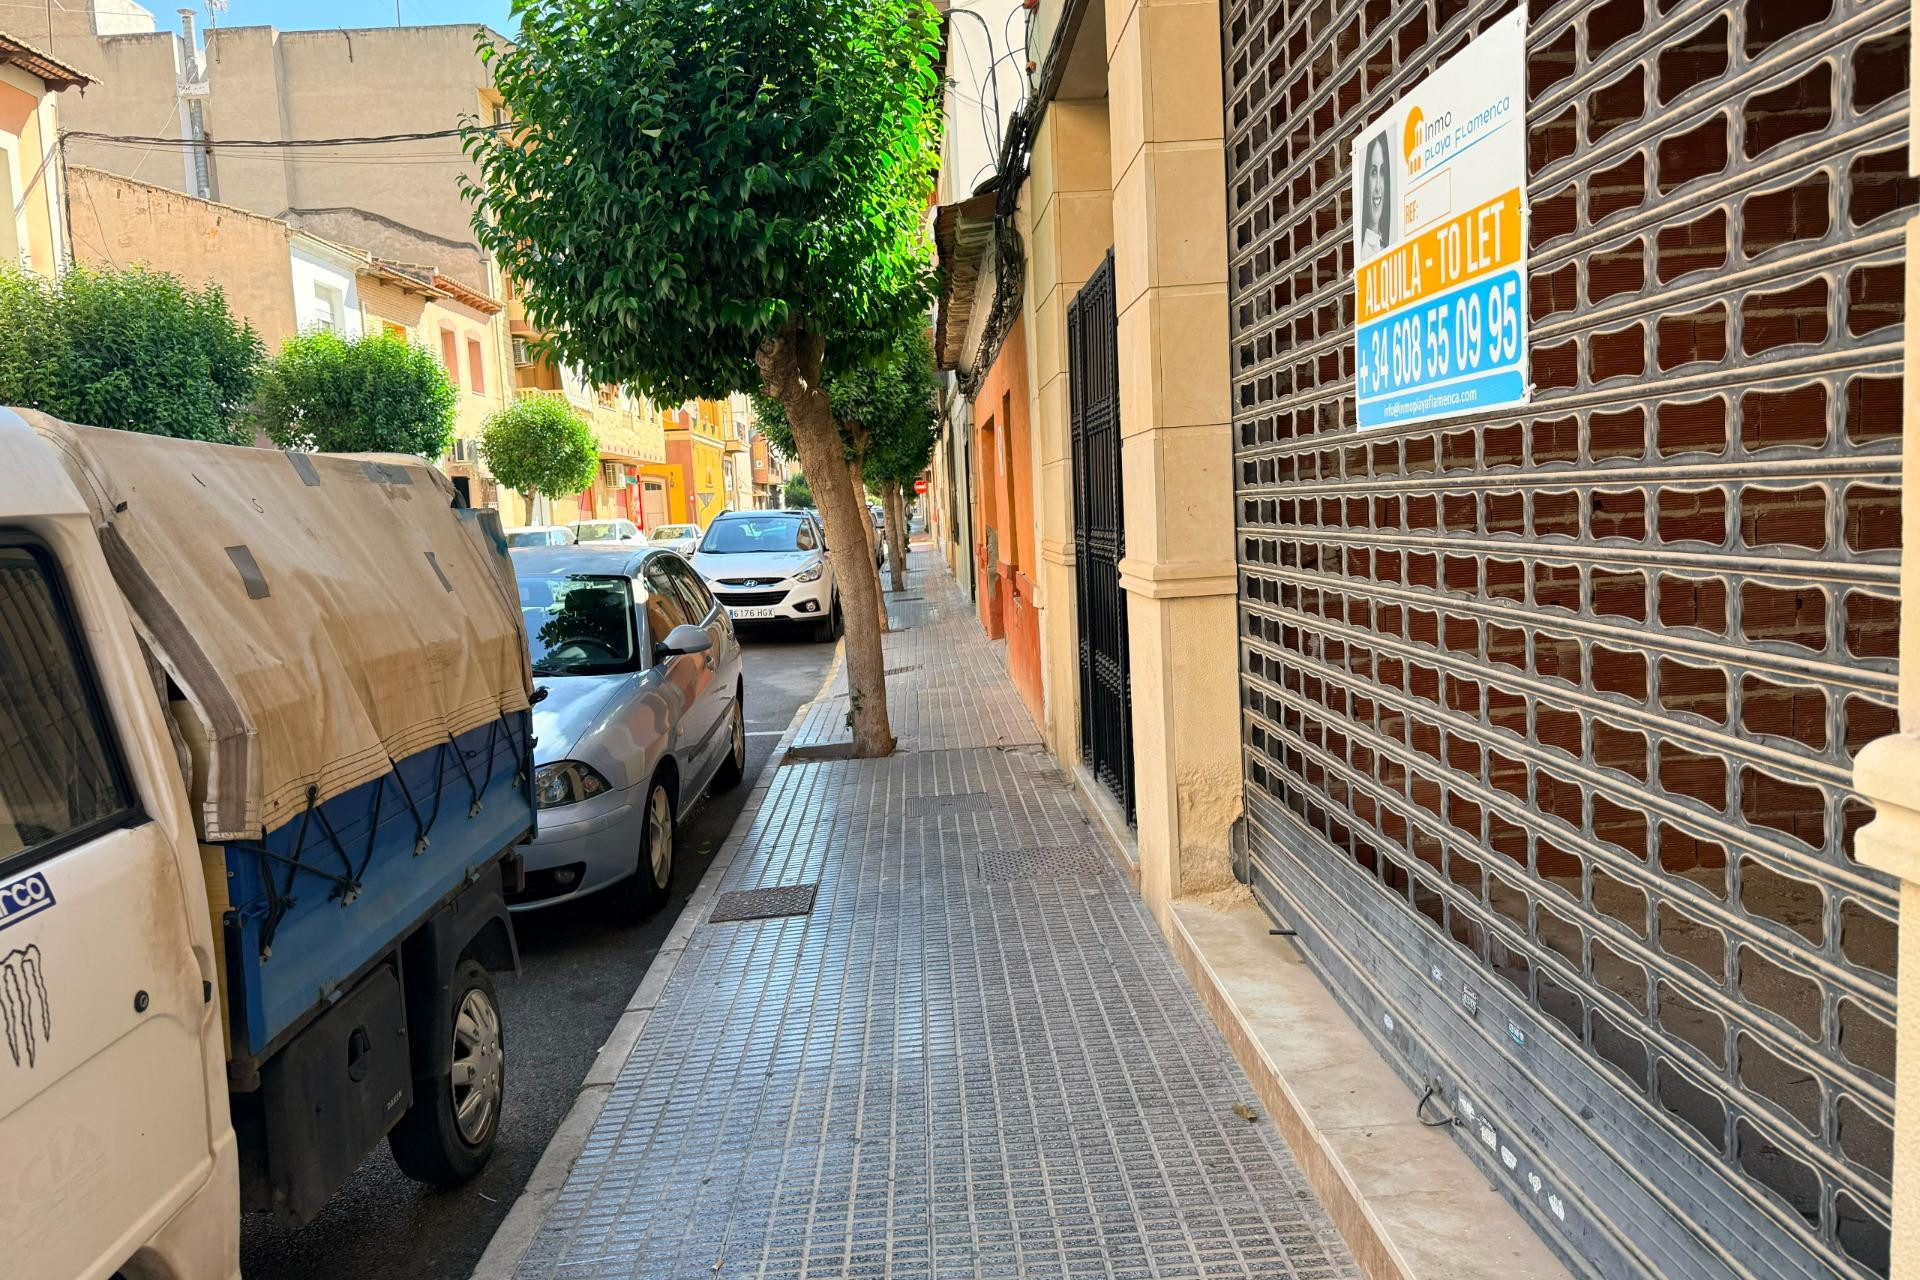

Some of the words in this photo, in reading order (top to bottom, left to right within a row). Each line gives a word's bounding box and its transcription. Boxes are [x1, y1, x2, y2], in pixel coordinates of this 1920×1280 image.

[1425, 111, 1451, 142] Inmo
[1405, 200, 1418, 224] REF:
[1365, 243, 1422, 316] ALQUILA
[1426, 258, 1433, 268] -
[1437, 223, 1461, 284] TO
[1466, 200, 1505, 273] LET
[1371, 327, 1389, 392] 34
[1392, 314, 1422, 387] 608
[1427, 304, 1449, 378] 55
[1455, 292, 1481, 371] 09
[1488, 280, 1517, 363] 95
[1383, 388, 1478, 418] info@inmoplayaflamenca.com
[733, 609, 755, 618] 6176
[757, 608, 774, 617] HGX
